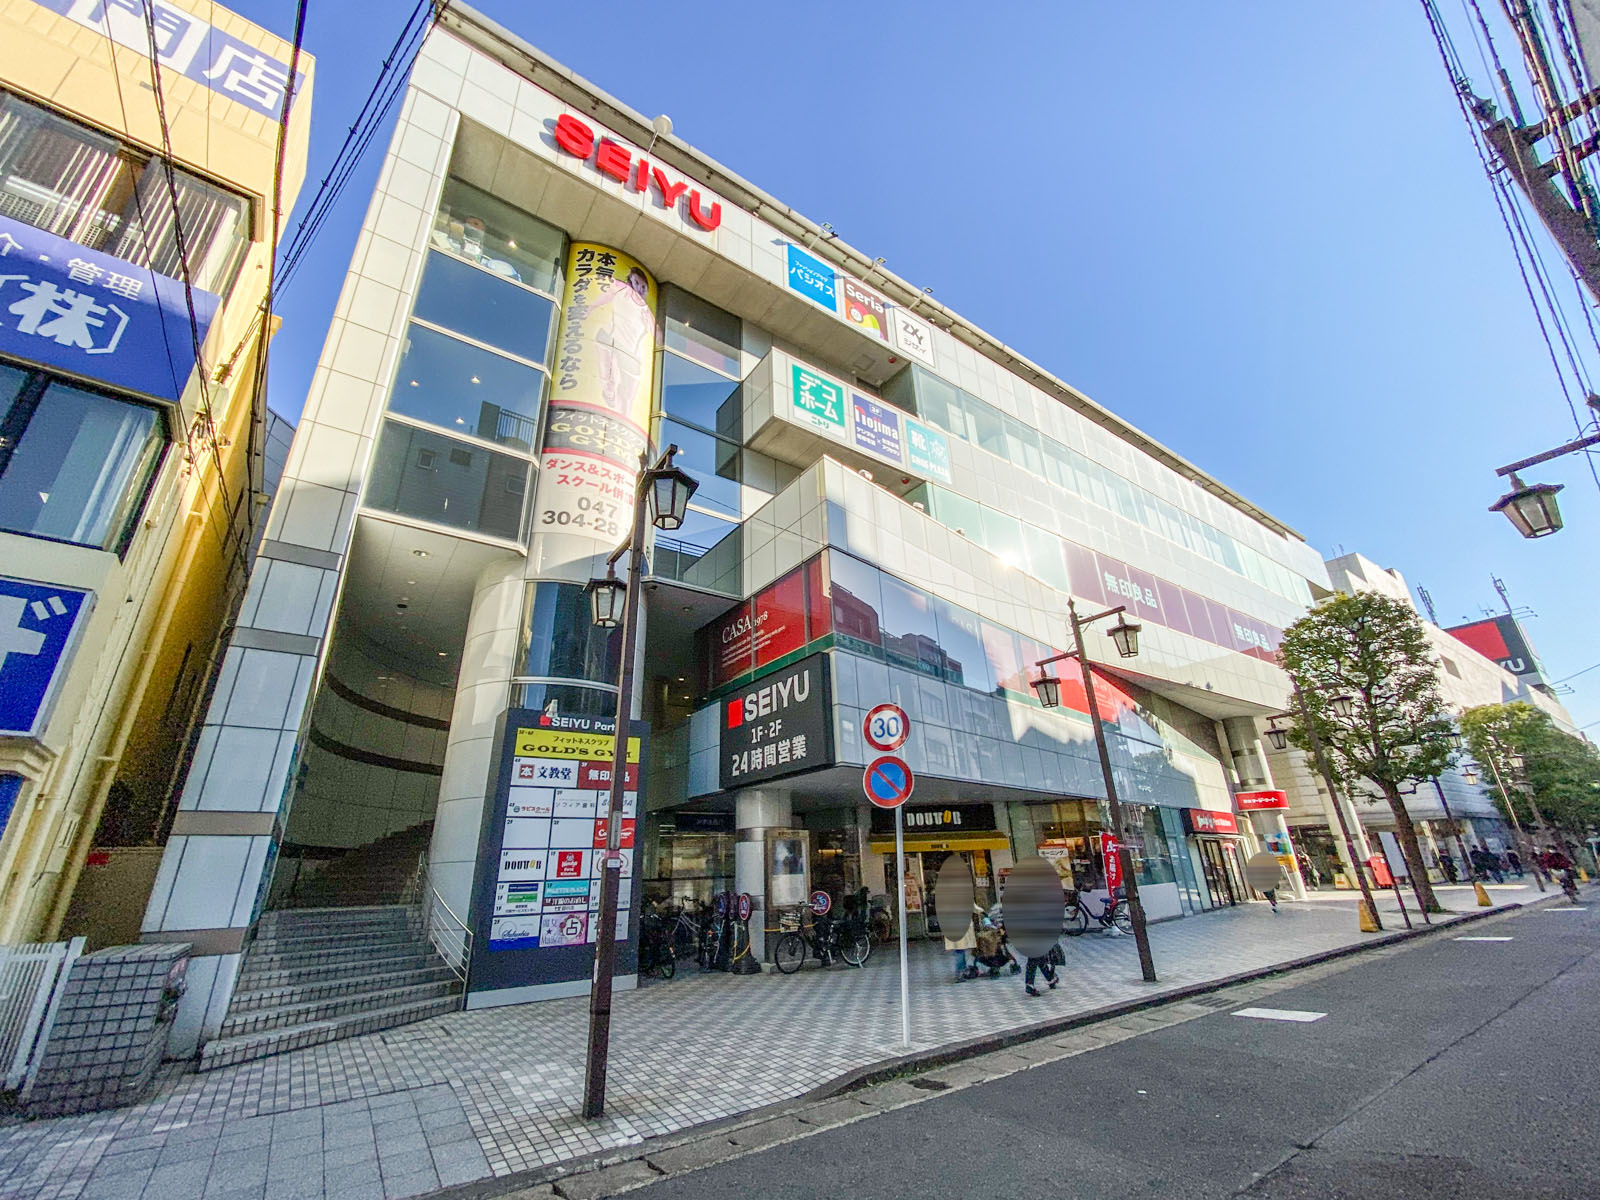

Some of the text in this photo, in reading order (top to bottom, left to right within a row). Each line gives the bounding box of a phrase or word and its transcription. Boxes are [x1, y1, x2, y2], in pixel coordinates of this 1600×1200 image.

[555, 113, 721, 231] SEIYU
[595, 251, 617, 293] 本気で
[790, 266, 836, 299] パシオス
[846, 282, 884, 314] Seria
[558, 248, 596, 391] カラダを変えるなら
[799, 372, 837, 403] デコ
[800, 390, 839, 421] ホーム
[811, 415, 830, 430] ニトリ
[854, 404, 898, 440] nojima
[577, 496, 618, 519] 047
[1104, 571, 1158, 609] 無印良品
[722, 615, 752, 644] CASA
[754, 610, 769, 627] 1978
[1234, 622, 1271, 651] 無印良品
[744, 669, 811, 722] SEIYU
[551, 716, 615, 732] SEIYU Part
[873, 717, 899, 738] 30
[522, 743, 589, 756] GOLD'S
[552, 734, 611, 746] フィットネスクラブ
[731, 734, 807, 777] 24時間営業
[520, 766, 533, 777] 本
[536, 765, 573, 781] 文教堂
[906, 809, 962, 827] DOUTOR
[504, 859, 542, 871] DOUTOR
[566, 918, 579, 936] 占
